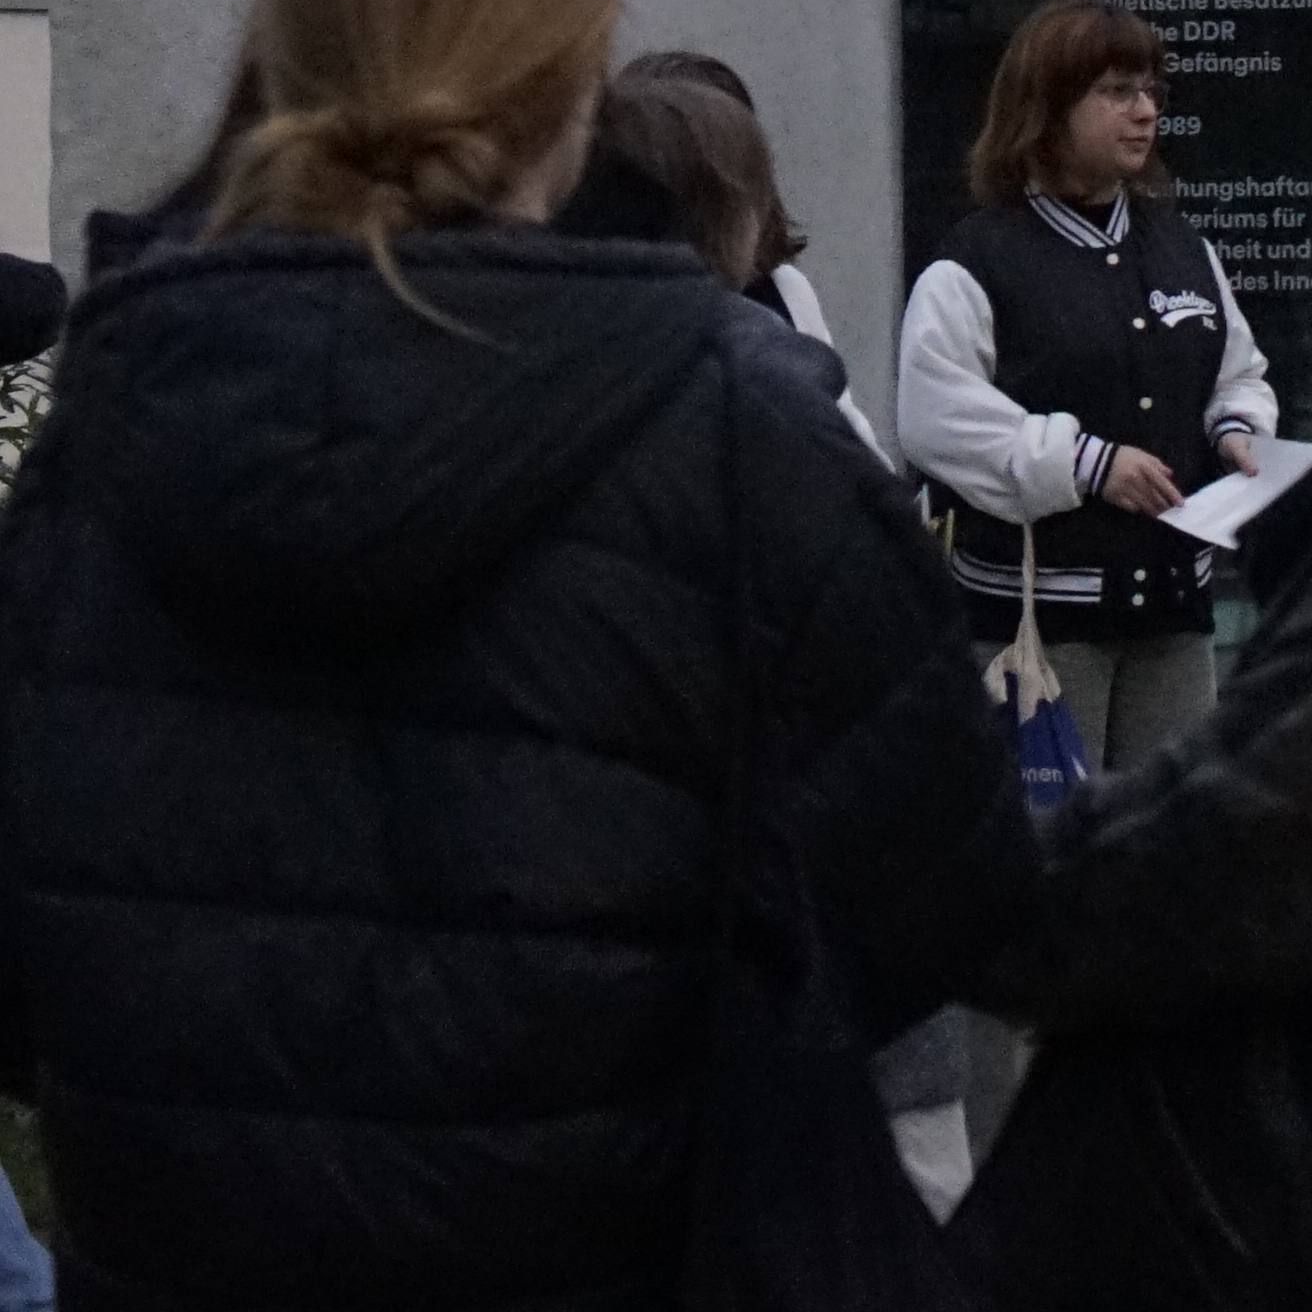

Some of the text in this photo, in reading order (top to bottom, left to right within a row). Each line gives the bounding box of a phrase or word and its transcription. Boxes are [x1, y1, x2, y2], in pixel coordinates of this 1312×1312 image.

[1183, 21, 1236, 42] DDR
[1162, 51, 1283, 77] Gefängnis
[1272, 206, 1307, 229] für
[1267, 237, 1312, 261] und
[1228, 270, 1270, 292] des
